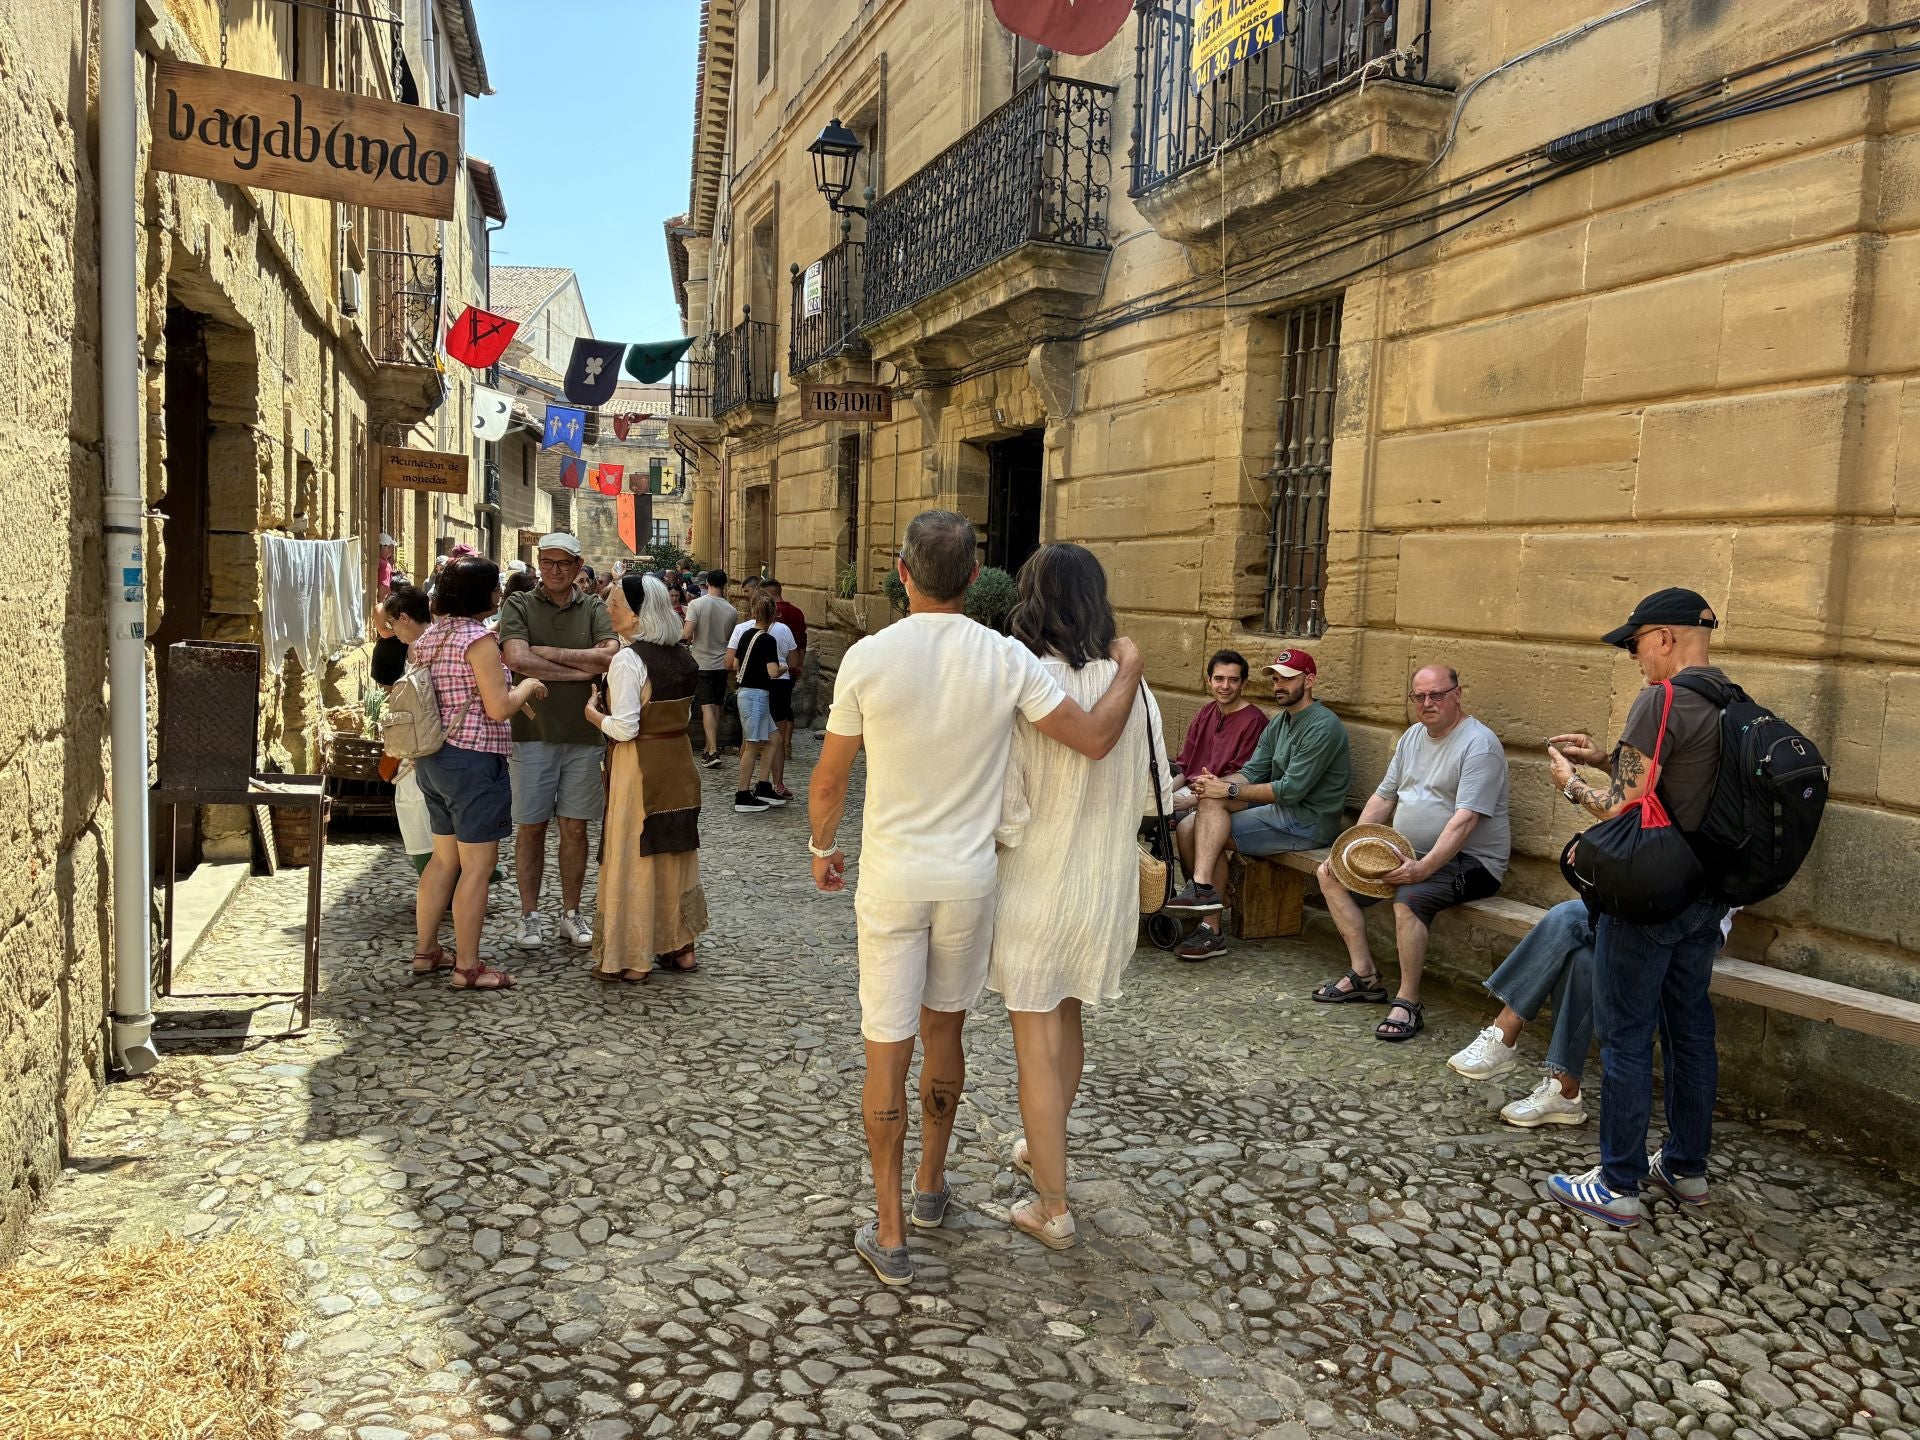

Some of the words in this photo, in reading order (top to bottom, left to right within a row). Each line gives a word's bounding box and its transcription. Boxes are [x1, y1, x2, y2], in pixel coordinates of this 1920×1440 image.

[1198, 6, 1222, 46] VISTA
[1240, 10, 1268, 32] HARO
[1196, 60, 1211, 93] 941
[1214, 46, 1230, 76] 30
[1234, 31, 1251, 60] 47
[1255, 18, 1274, 49] 94
[809, 391, 882, 412] ABADIA
[448, 461, 460, 471] de
[402, 474, 448, 485] monedas
